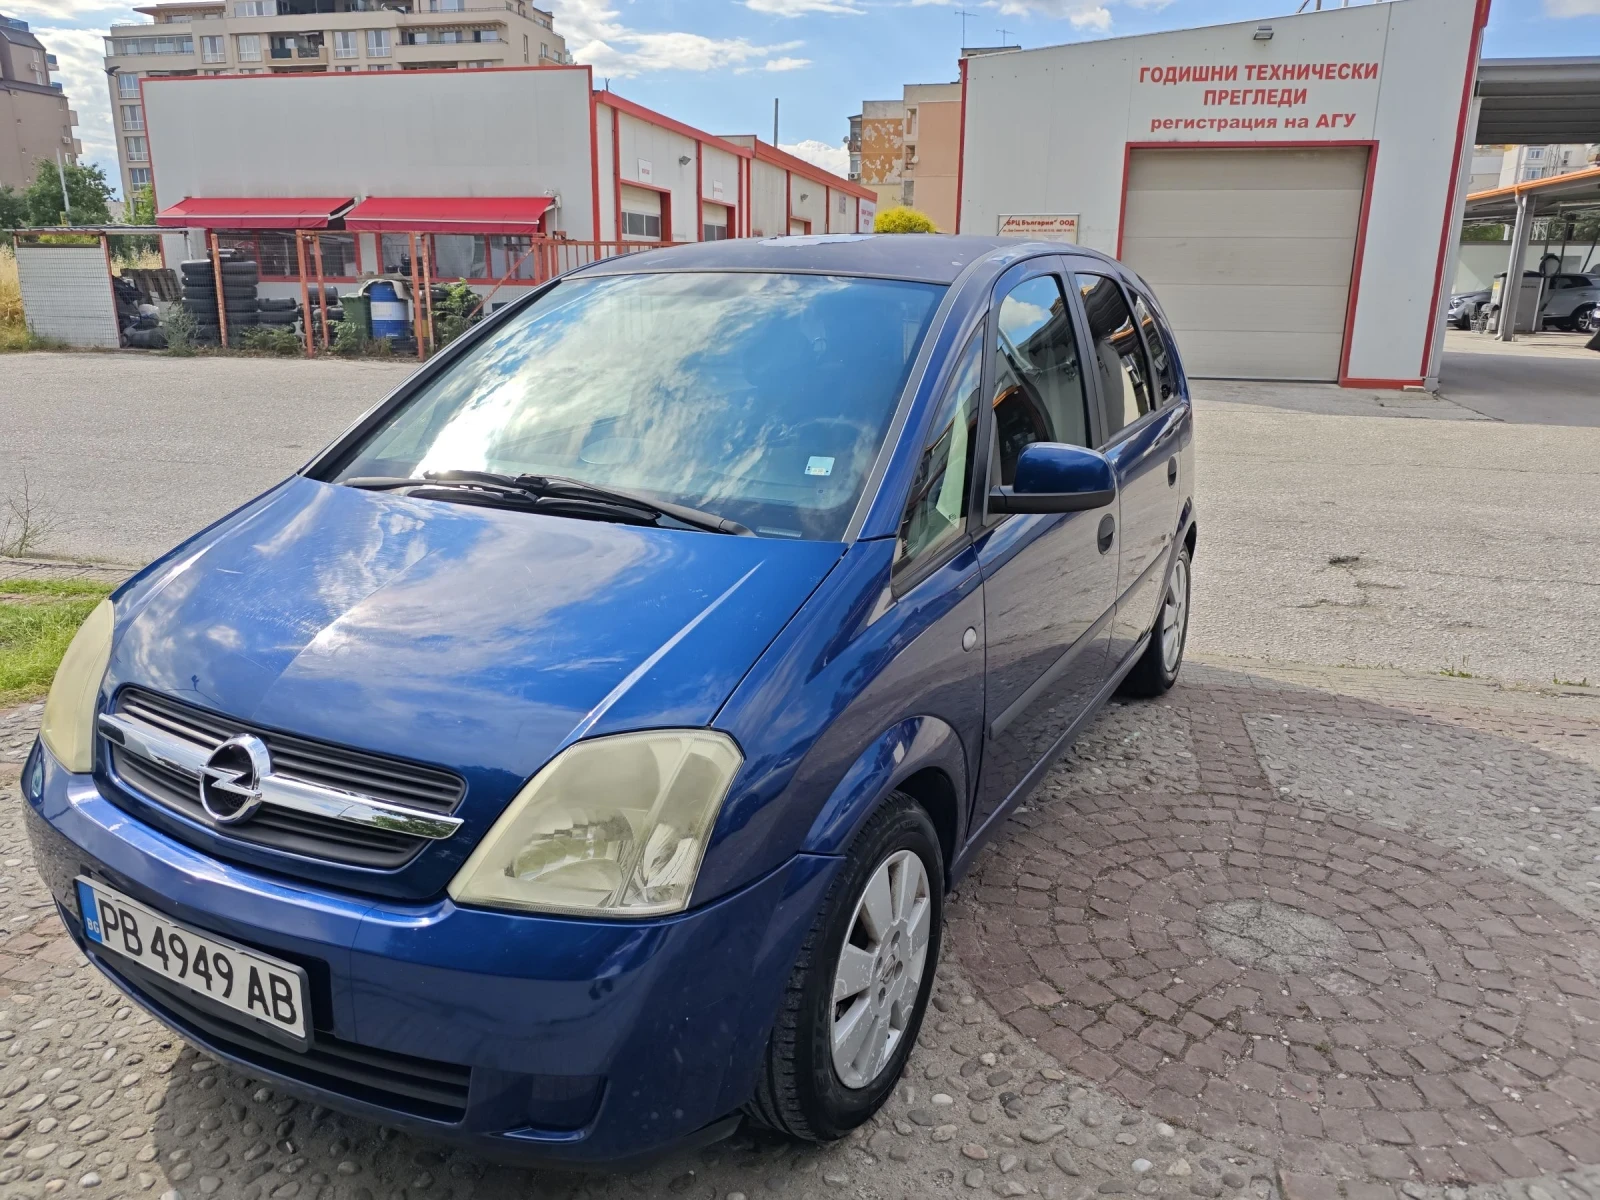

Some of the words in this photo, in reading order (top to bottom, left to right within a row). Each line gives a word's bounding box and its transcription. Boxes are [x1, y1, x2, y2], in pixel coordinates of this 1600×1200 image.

[1139, 65, 1238, 86] ГОДИШНИ
[1244, 63, 1379, 82] ТЕХНИЧЕСКИ
[1203, 88, 1308, 108] ПРЕГЛЕДИ
[1150, 117, 1277, 132] регистрация
[1284, 116, 1309, 129] на
[1315, 113, 1356, 128] АГУ
[86, 916, 100, 934] BG
[98, 898, 143, 956] PB
[151, 926, 234, 999] 4949
[247, 965, 297, 1025] AB
